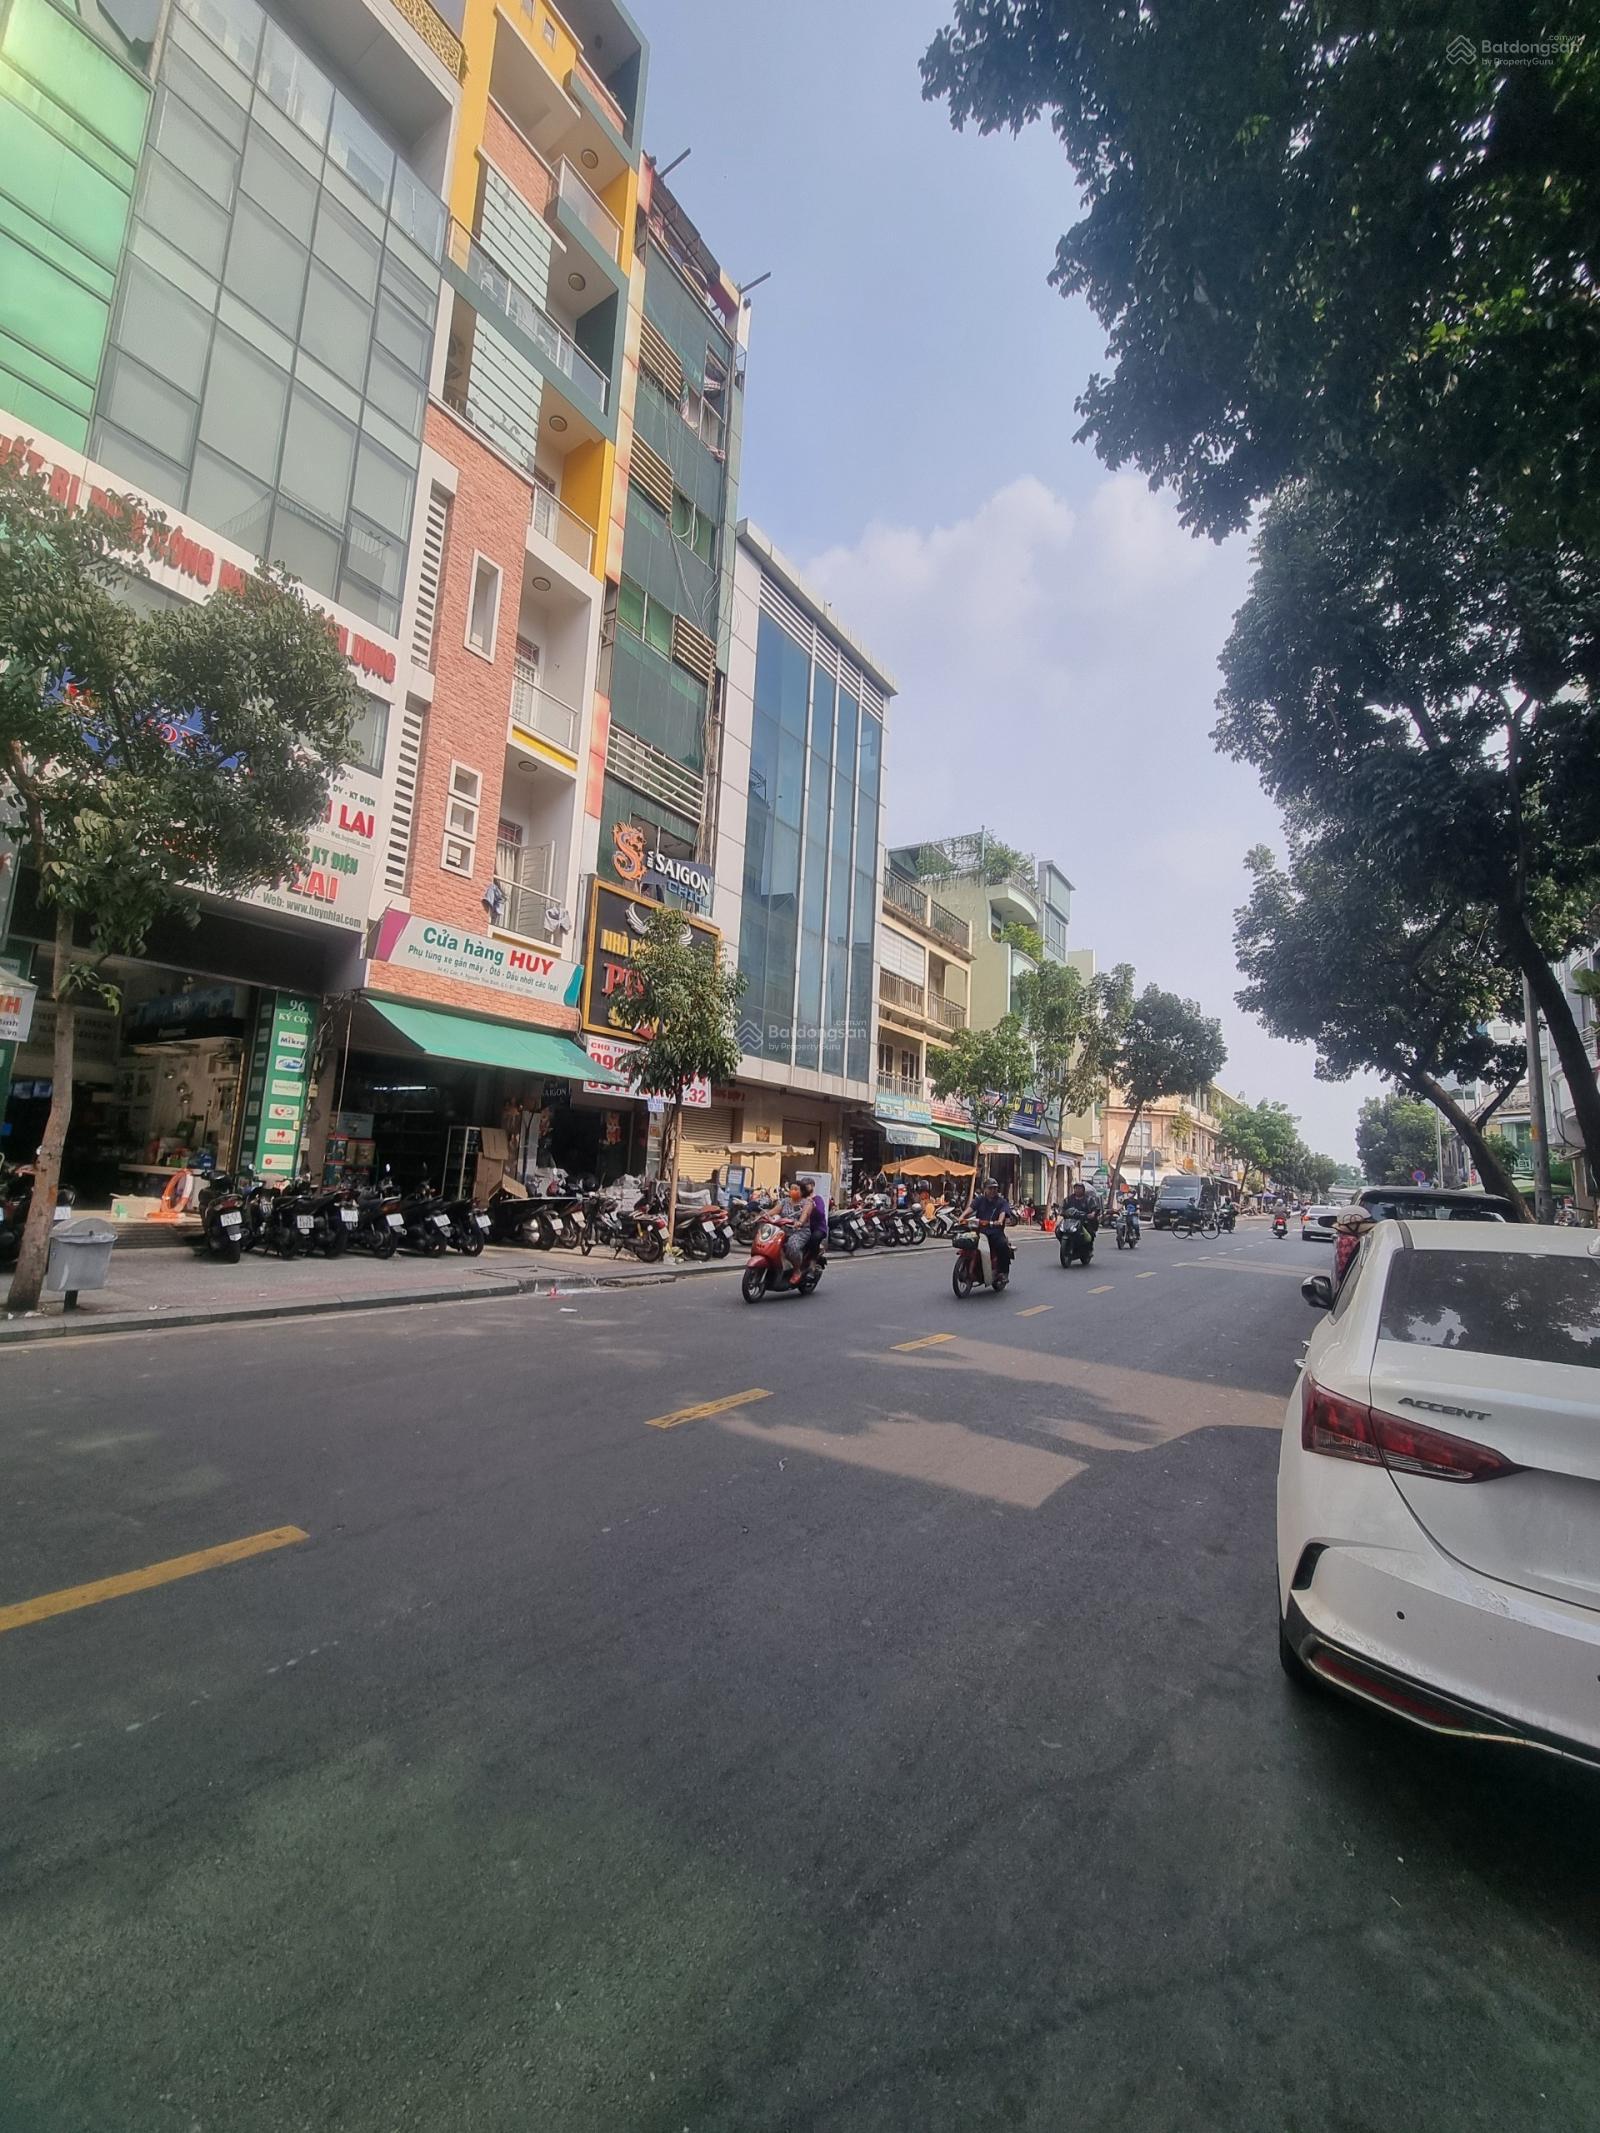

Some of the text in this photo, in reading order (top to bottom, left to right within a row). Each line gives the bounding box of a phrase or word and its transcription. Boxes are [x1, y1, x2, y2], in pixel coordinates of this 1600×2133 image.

[339, 805, 374, 838] LAI
[655, 853, 711, 896] SAIGON
[286, 902, 361, 928] www.huynhlai.com
[407, 944, 423, 958] Phụ
[443, 955, 453, 965] xe
[423, 926, 554, 975] Cửa hàng HUY
[600, 928, 630, 958] NHÀ
[289, 999, 305, 1013] 96
[293, 1014, 313, 1025] CON
[590, 1041, 611, 1051] CHO
[1397, 1397, 1492, 1421] ACCENT
